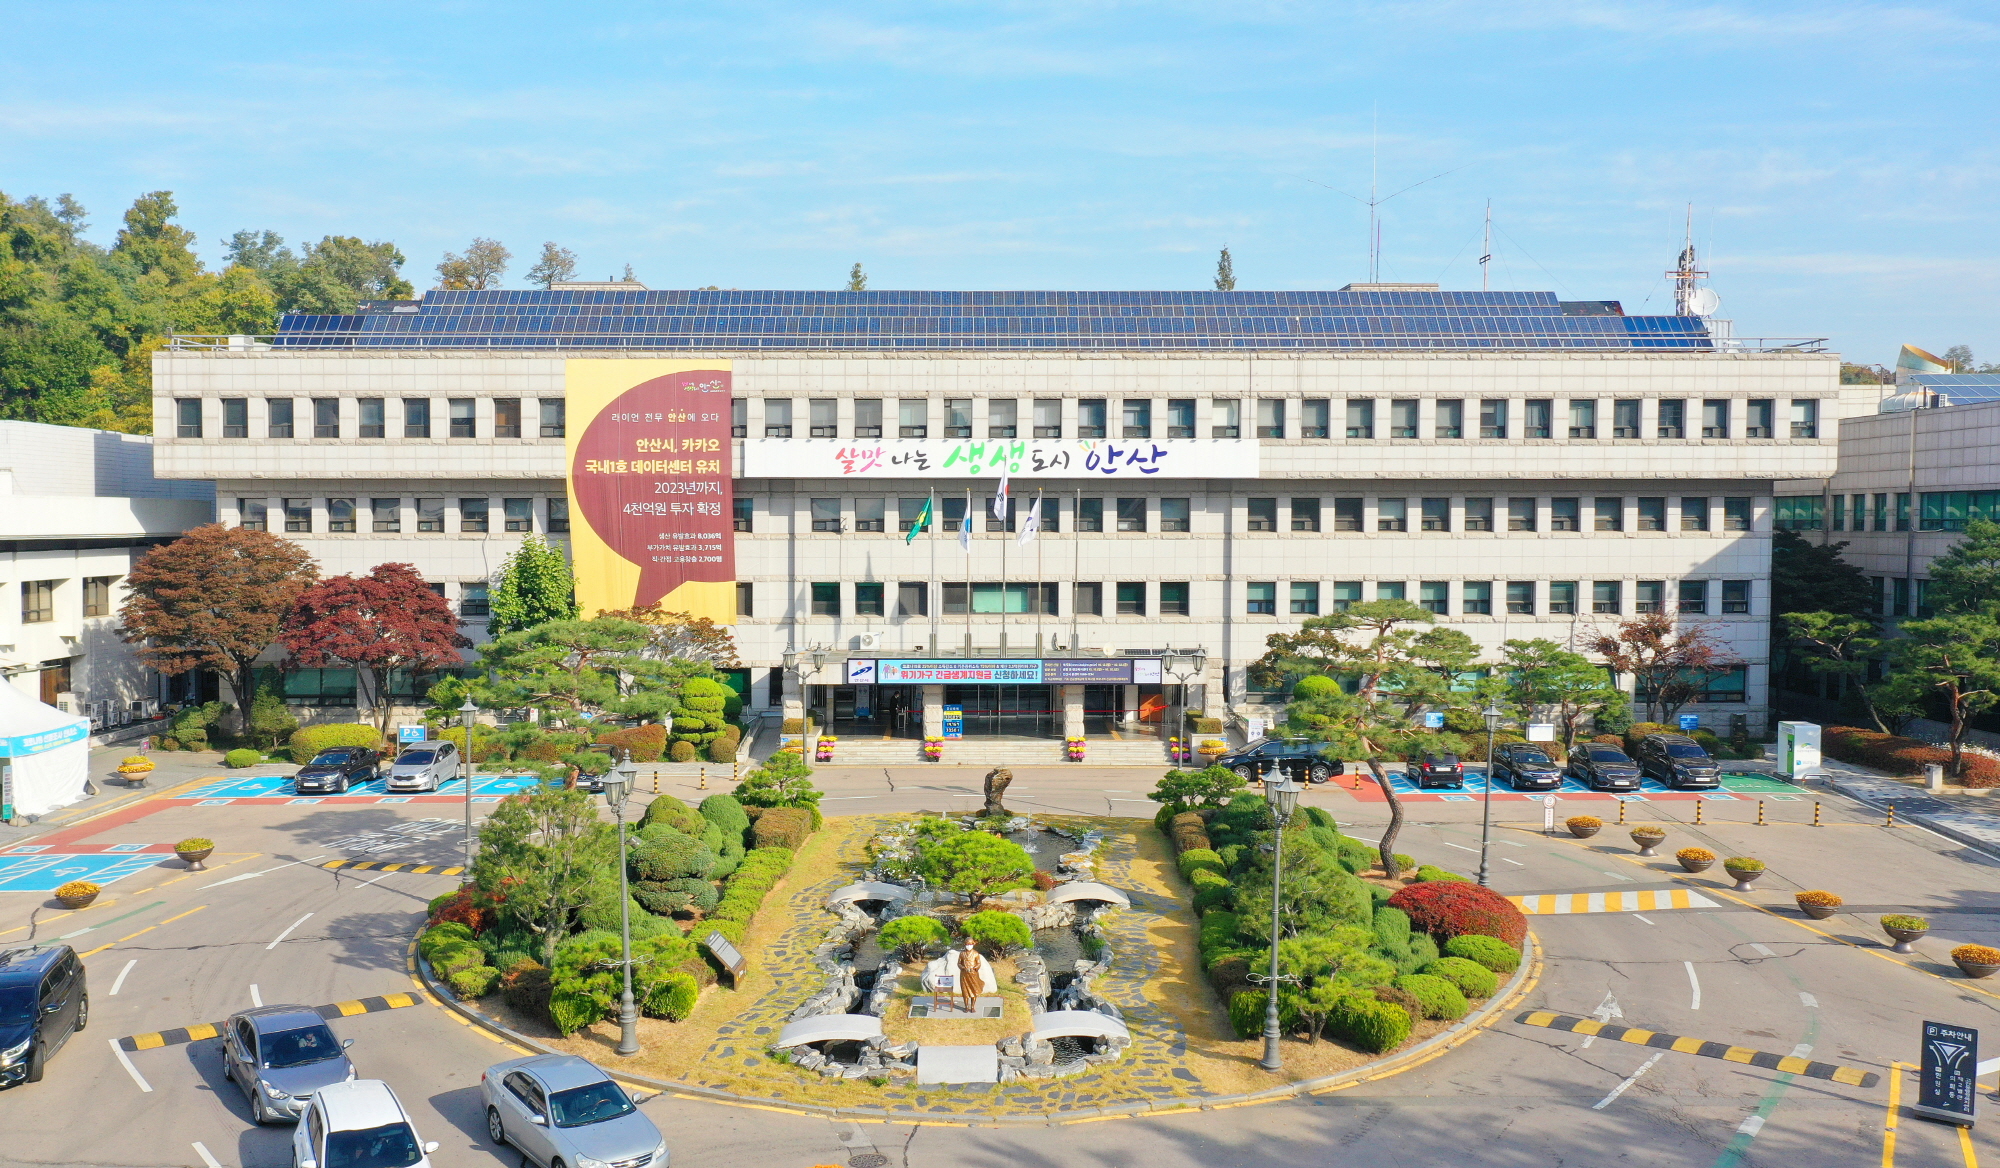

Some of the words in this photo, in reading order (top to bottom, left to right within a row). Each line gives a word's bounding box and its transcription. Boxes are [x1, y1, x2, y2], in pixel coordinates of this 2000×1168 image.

[611, 412, 639, 423] 라이언
[644, 412, 663, 423] 전무
[667, 410, 696, 423] 안산에
[700, 412, 720, 423] 오다
[636, 438, 678, 453] 안산시,
[681, 438, 721, 452] 카카오
[835, 446, 886, 475] 살맛
[891, 449, 931, 472] 나는
[942, 441, 1025, 475] 생생
[1032, 449, 1070, 472] 도시
[1085, 444, 1168, 475] 안산
[585, 459, 628, 474] 국내1호
[631, 459, 692, 475] 데이터센터
[695, 459, 720, 475] 유치
[654, 481, 723, 495] 2023년까지,
[623, 502, 667, 516] 4천억원
[670, 502, 695, 516] 투자
[697, 502, 721, 516] 확정
[900, 670, 933, 680] 위기가구
[935, 670, 992, 680] 긴급생계지원금
[994, 670, 1038, 680] 신청하세요!
[403, 728, 410, 737] P
[1940, 1028, 1972, 1042] 주차안내
